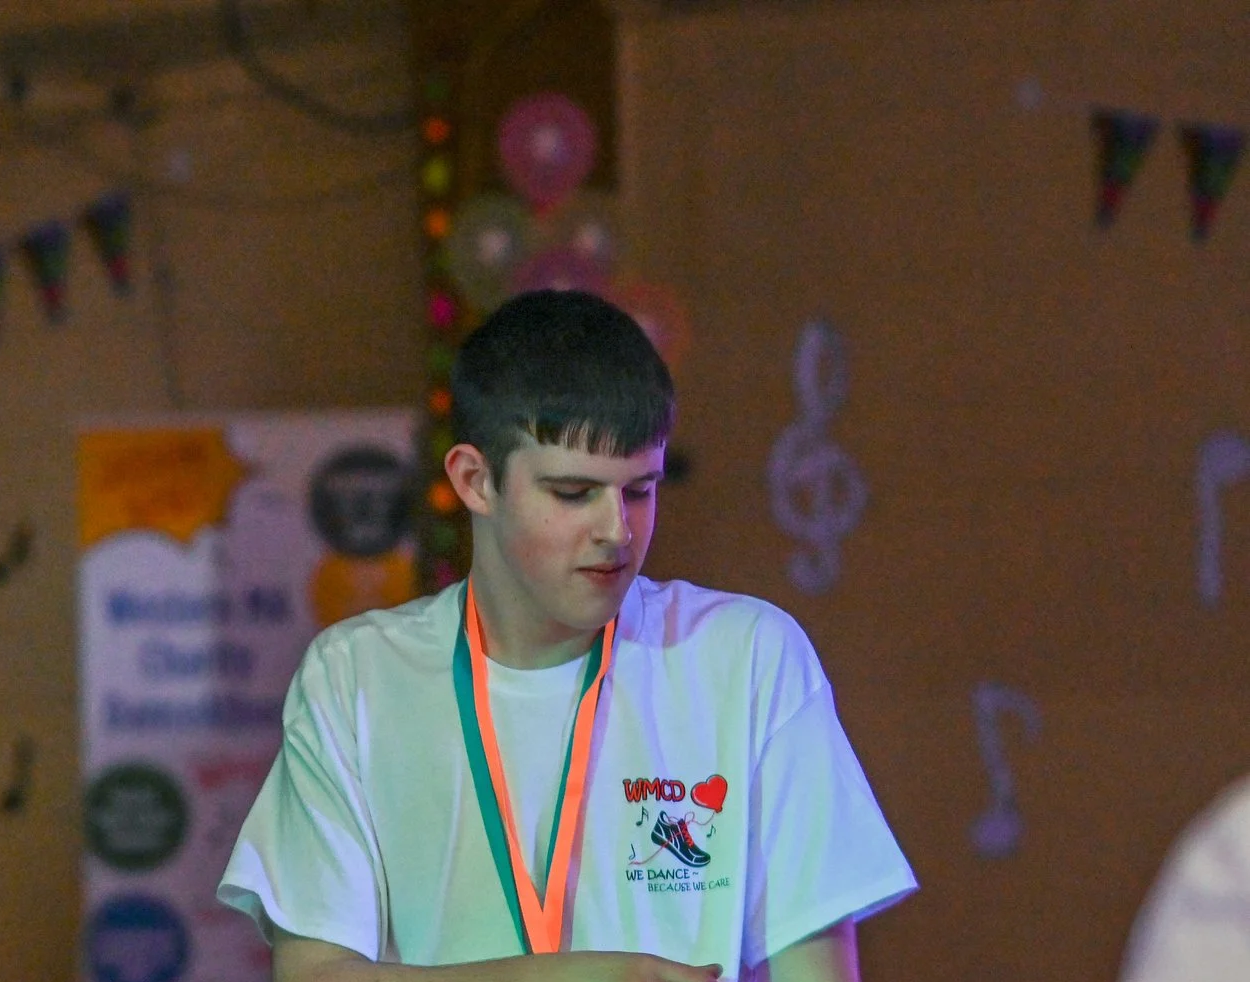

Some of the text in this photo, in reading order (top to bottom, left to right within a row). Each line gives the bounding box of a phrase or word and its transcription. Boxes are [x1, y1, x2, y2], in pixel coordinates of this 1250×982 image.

[622, 777, 686, 803] WMCD
[626, 869, 644, 881] WE
[647, 868, 690, 881] DANCE
[647, 877, 730, 893] BECAUSE WE CARE
